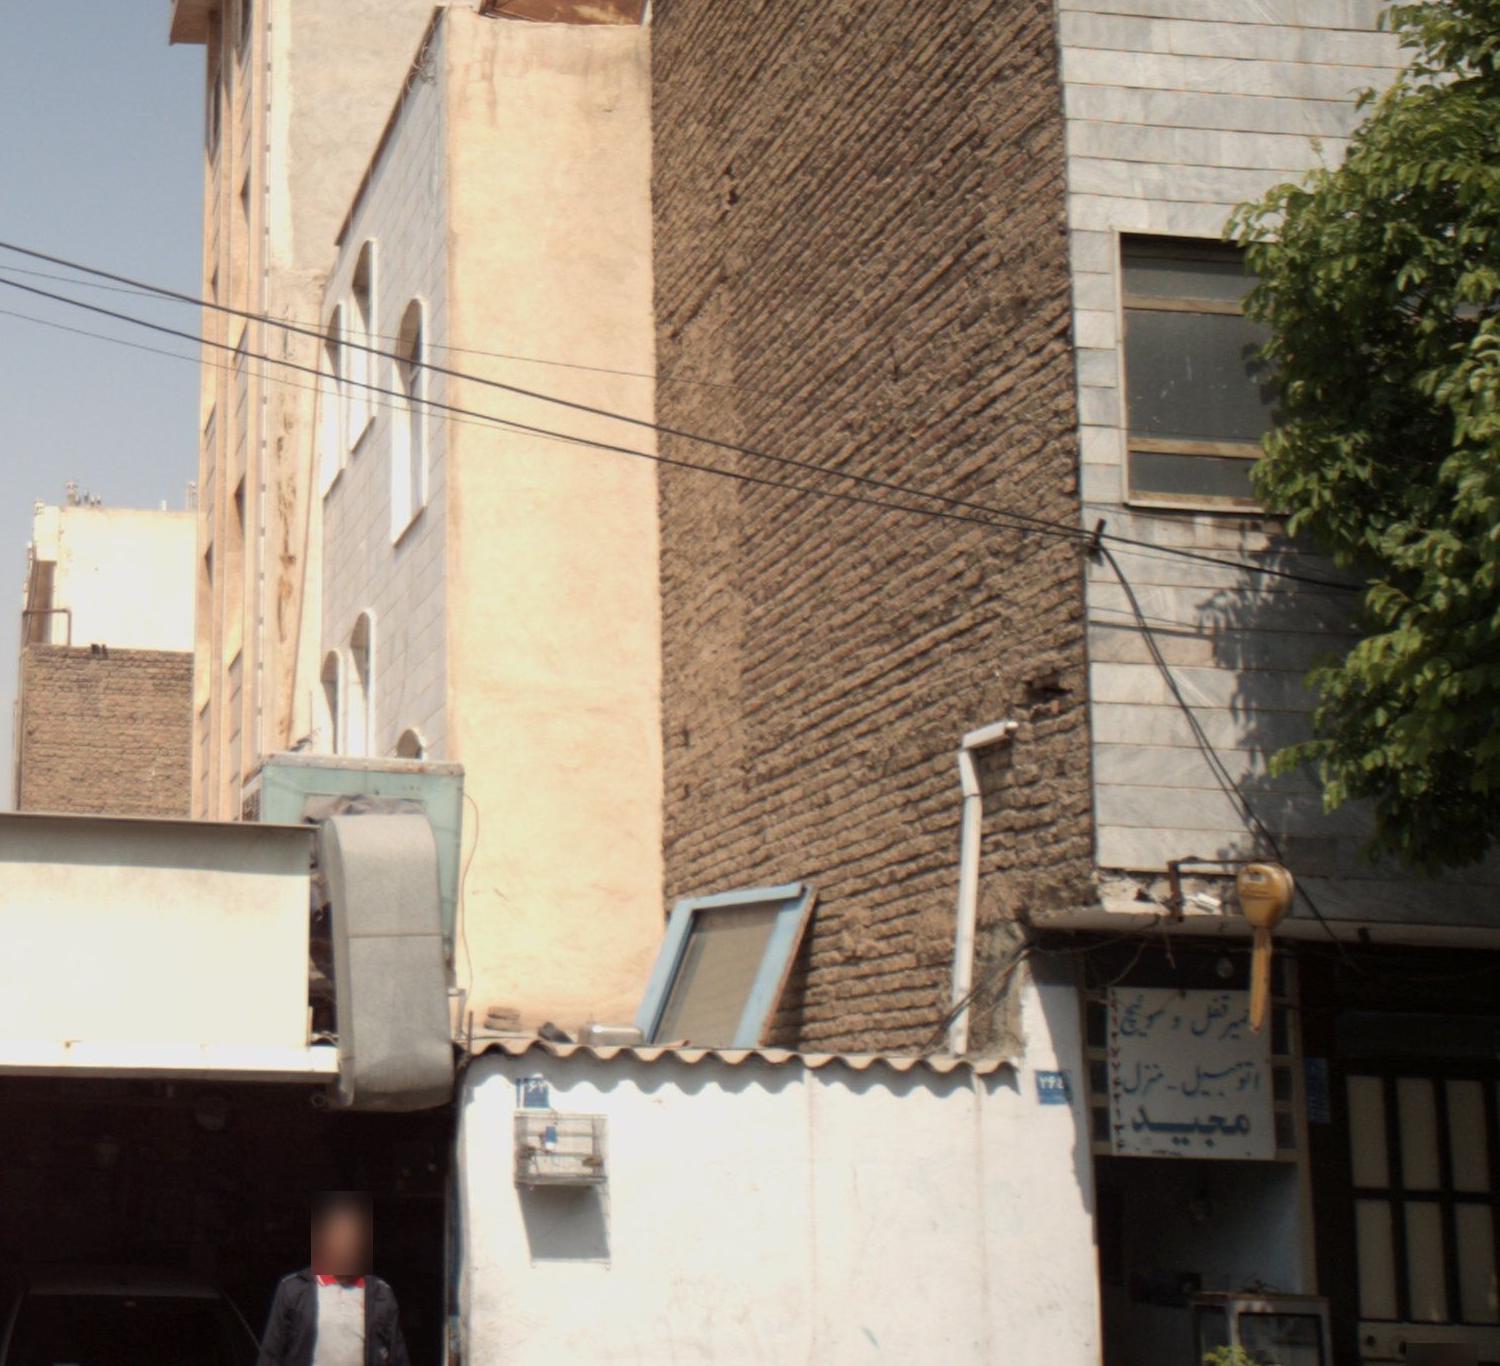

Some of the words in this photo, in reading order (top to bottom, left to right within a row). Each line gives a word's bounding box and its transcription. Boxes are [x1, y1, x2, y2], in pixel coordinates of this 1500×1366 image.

[1171, 1014, 1182, 1030] و
[1191, 994, 1231, 1037] قفل
[1131, 1103, 1250, 1148] مجید
